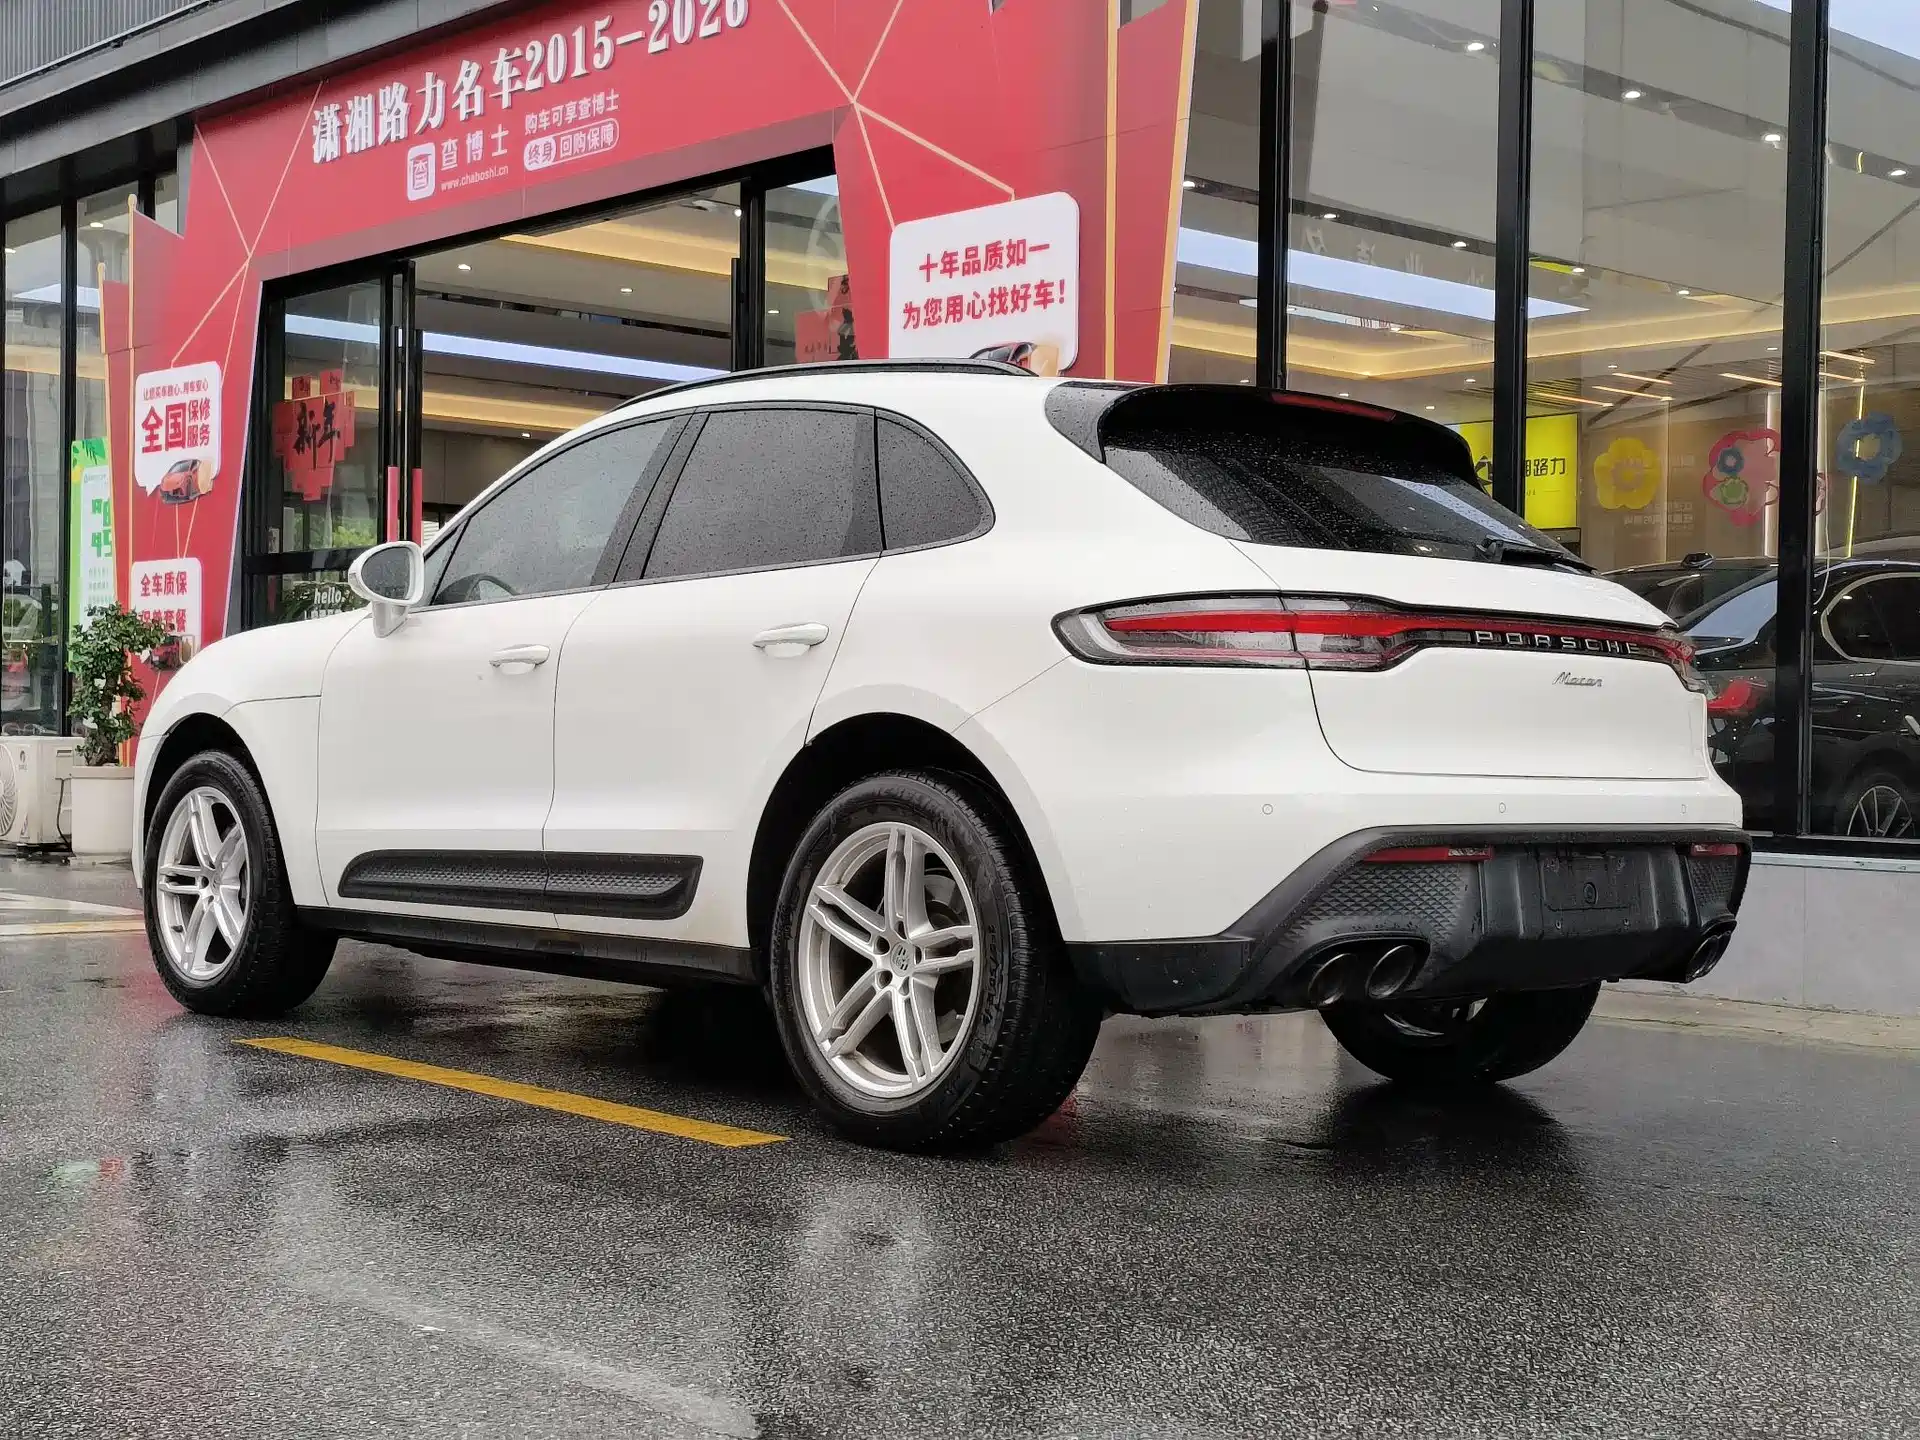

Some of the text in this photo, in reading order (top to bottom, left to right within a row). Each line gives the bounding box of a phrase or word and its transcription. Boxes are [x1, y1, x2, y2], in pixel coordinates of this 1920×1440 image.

[524, 88, 620, 136] 购车可享查博士
[441, 123, 510, 171] 查博士
[527, 123, 615, 166] 终身 回购保障
[440, 164, 509, 192] www.chaboshi.cn
[918, 238, 1050, 283] 十年品质如一
[187, 396, 211, 423] 保修
[141, 403, 187, 453] 全国
[186, 422, 211, 449] 服务
[140, 570, 188, 597] 全车质保
[1474, 630, 1640, 654] PORSCHE
[1552, 671, 1603, 688] Macan
